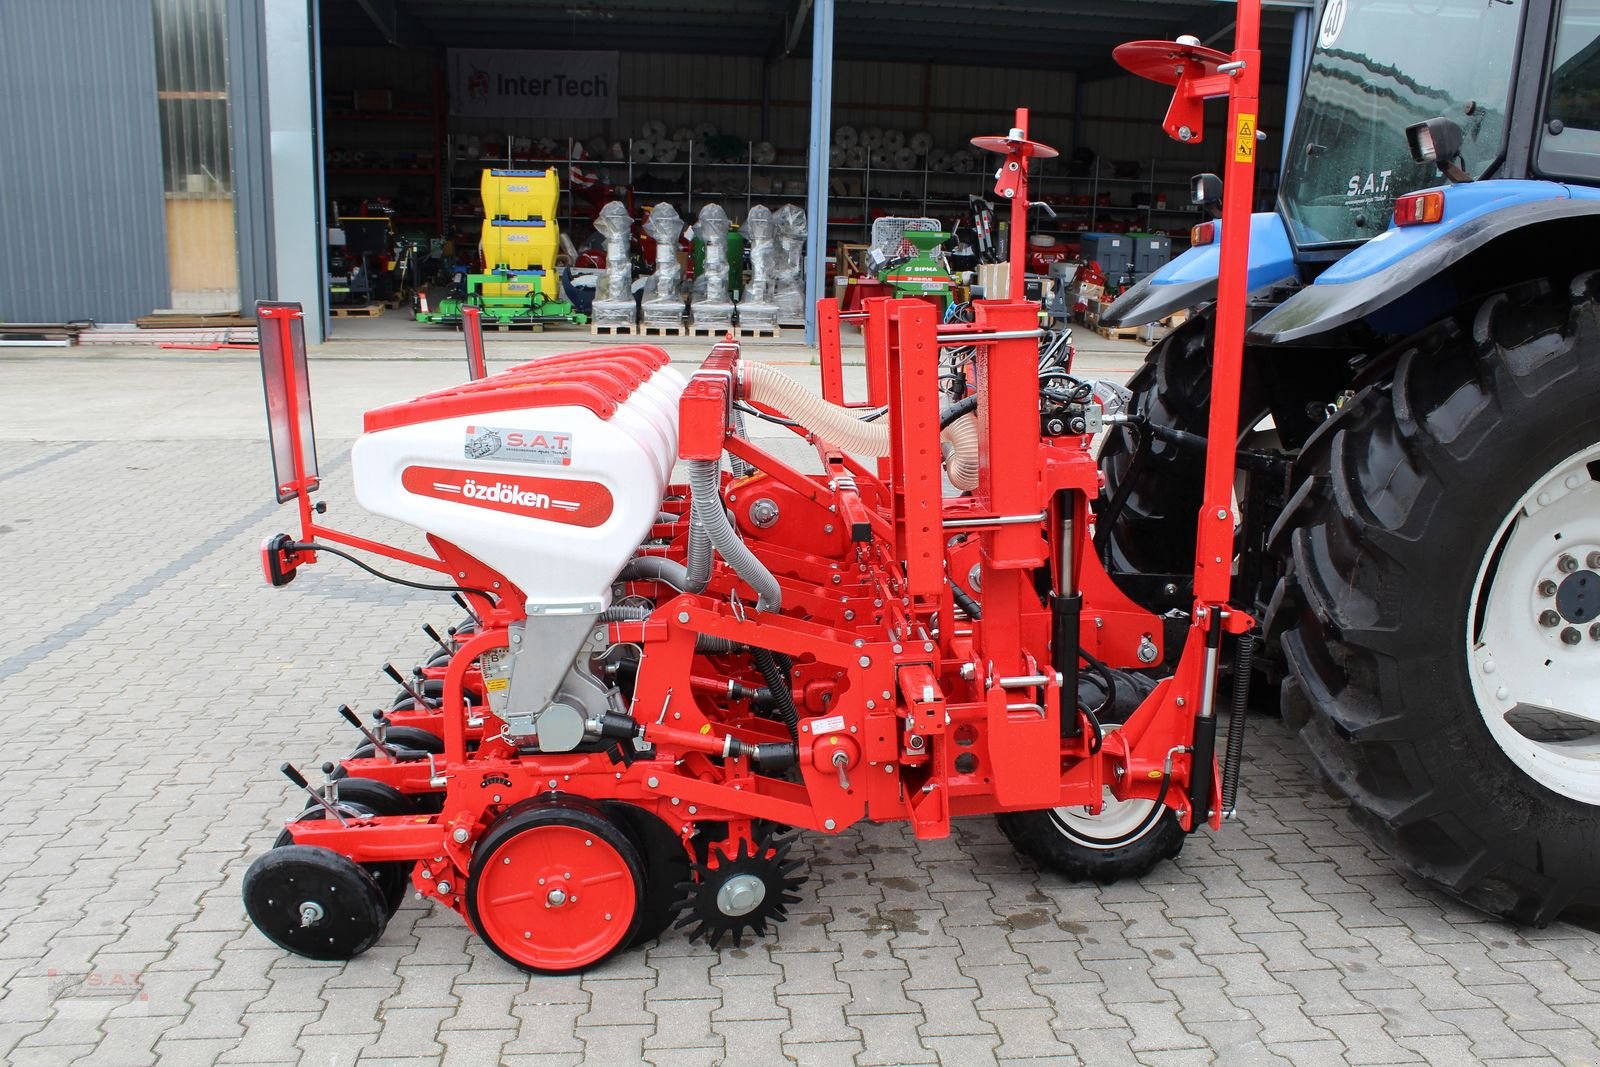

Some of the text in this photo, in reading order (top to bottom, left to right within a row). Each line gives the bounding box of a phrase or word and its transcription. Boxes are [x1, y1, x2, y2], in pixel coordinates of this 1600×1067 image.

[1323, 1, 1342, 38] 40
[1347, 169, 1392, 197] S.A.T.
[506, 432, 569, 450] S.A.T.
[463, 479, 549, 509] özdöken
